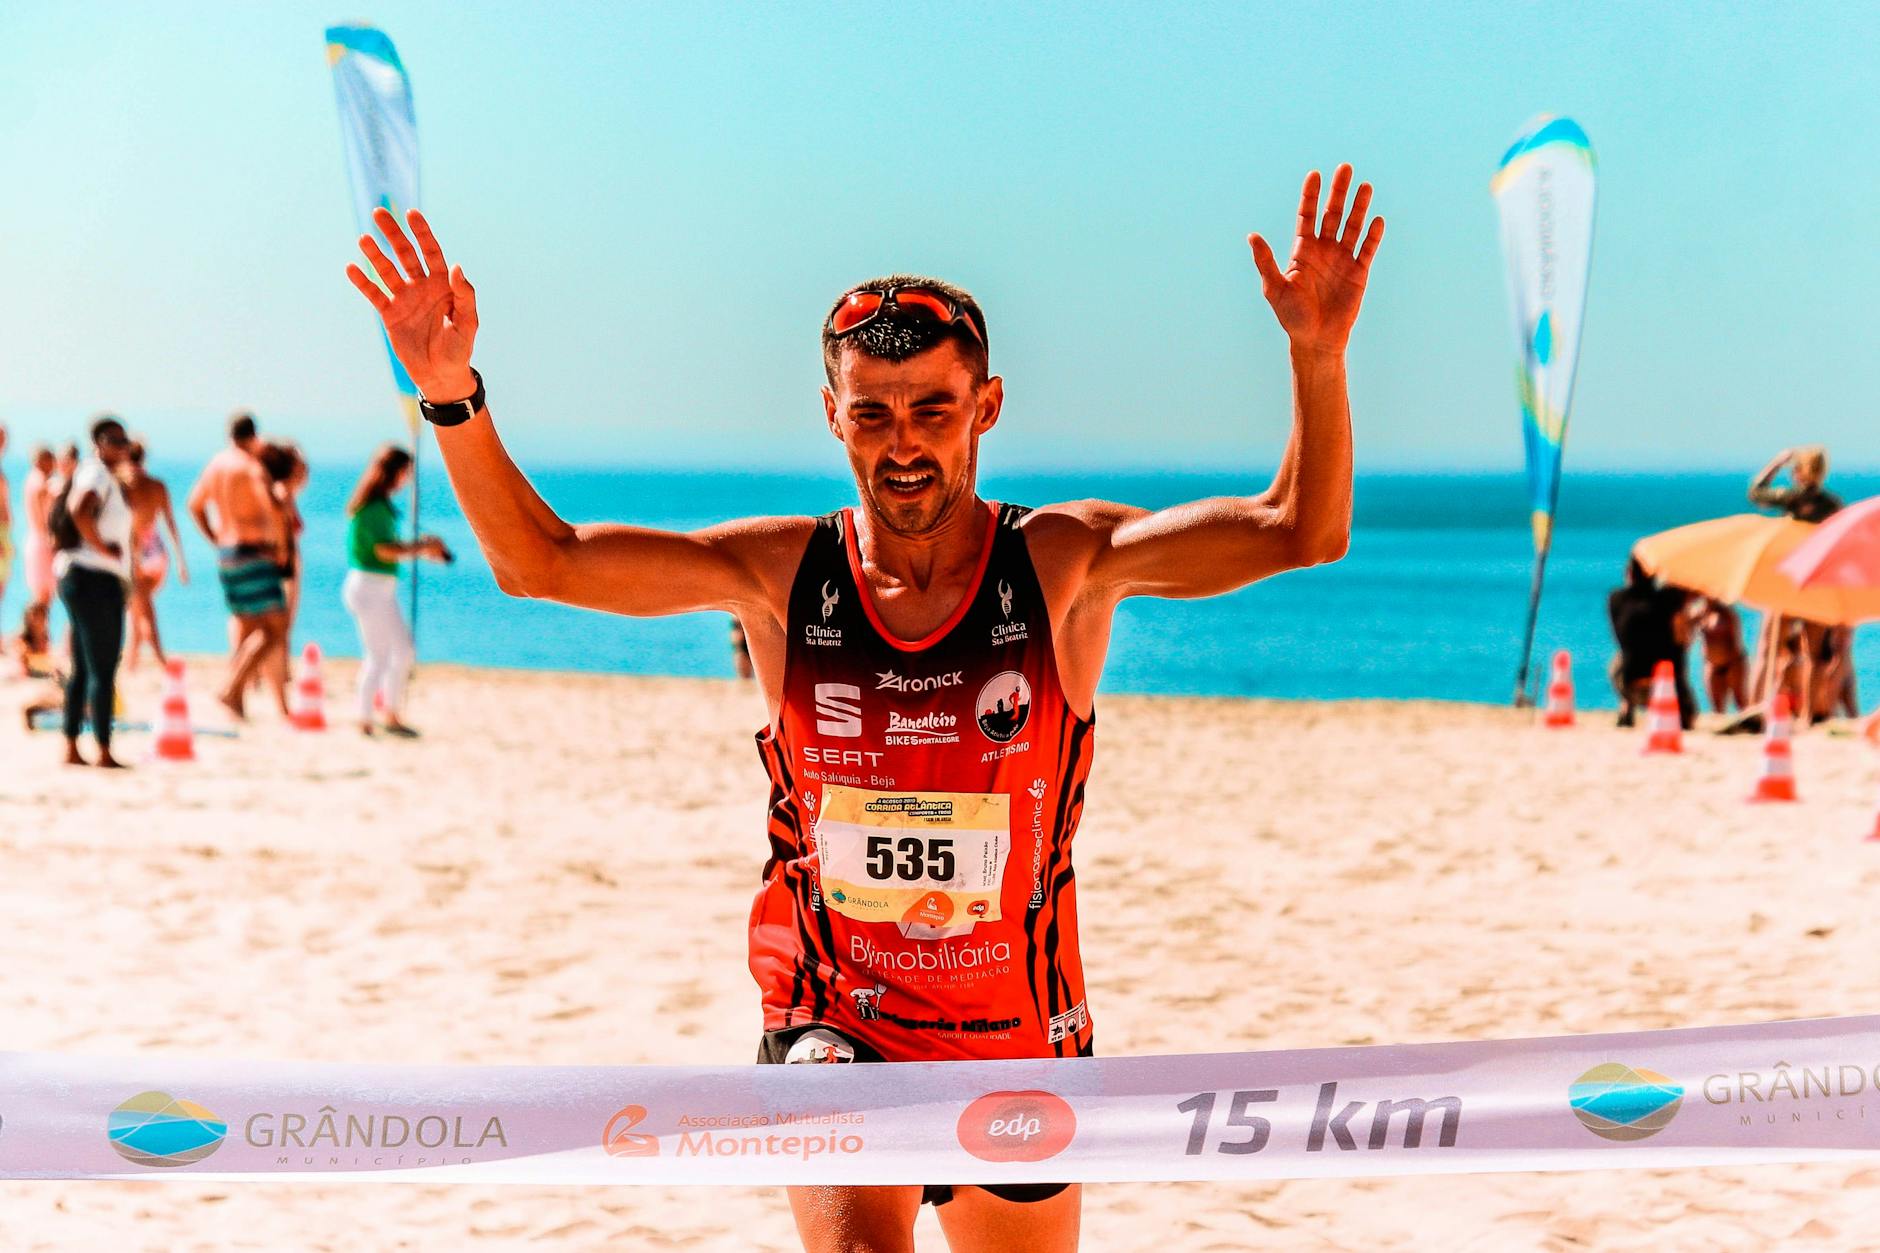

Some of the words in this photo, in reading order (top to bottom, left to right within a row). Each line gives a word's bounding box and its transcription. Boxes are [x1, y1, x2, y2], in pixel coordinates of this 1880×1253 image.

[805, 624, 842, 638] Clínica
[991, 621, 1027, 637] Clínica
[817, 638, 842, 647] Beatriz
[885, 735, 918, 746] BIKES
[803, 747, 884, 767] SEAT
[980, 741, 1030, 763] ATLETISMO
[803, 768, 820, 779] Auto
[870, 775, 896, 788] Beja
[866, 803, 903, 811] CORRIDA
[866, 835, 955, 882] 535
[1029, 801, 1044, 910] fisionasceclinic
[847, 896, 889, 909] GRÂNDOLA
[927, 975, 943, 983] DE
[950, 966, 1010, 982] MEDIAÇÃO
[1703, 1060, 1880, 1105] GRÂND
[245, 1104, 508, 1149] GRÂNDOLA
[677, 1112, 769, 1129] Associação
[775, 1111, 865, 1126] Mutualista
[987, 1113, 1042, 1140] edp
[1176, 1089, 1279, 1156] 15
[1305, 1081, 1464, 1152] km
[676, 1129, 864, 1161] Montepio
[277, 1155, 473, 1166] MUNICÍPIO
